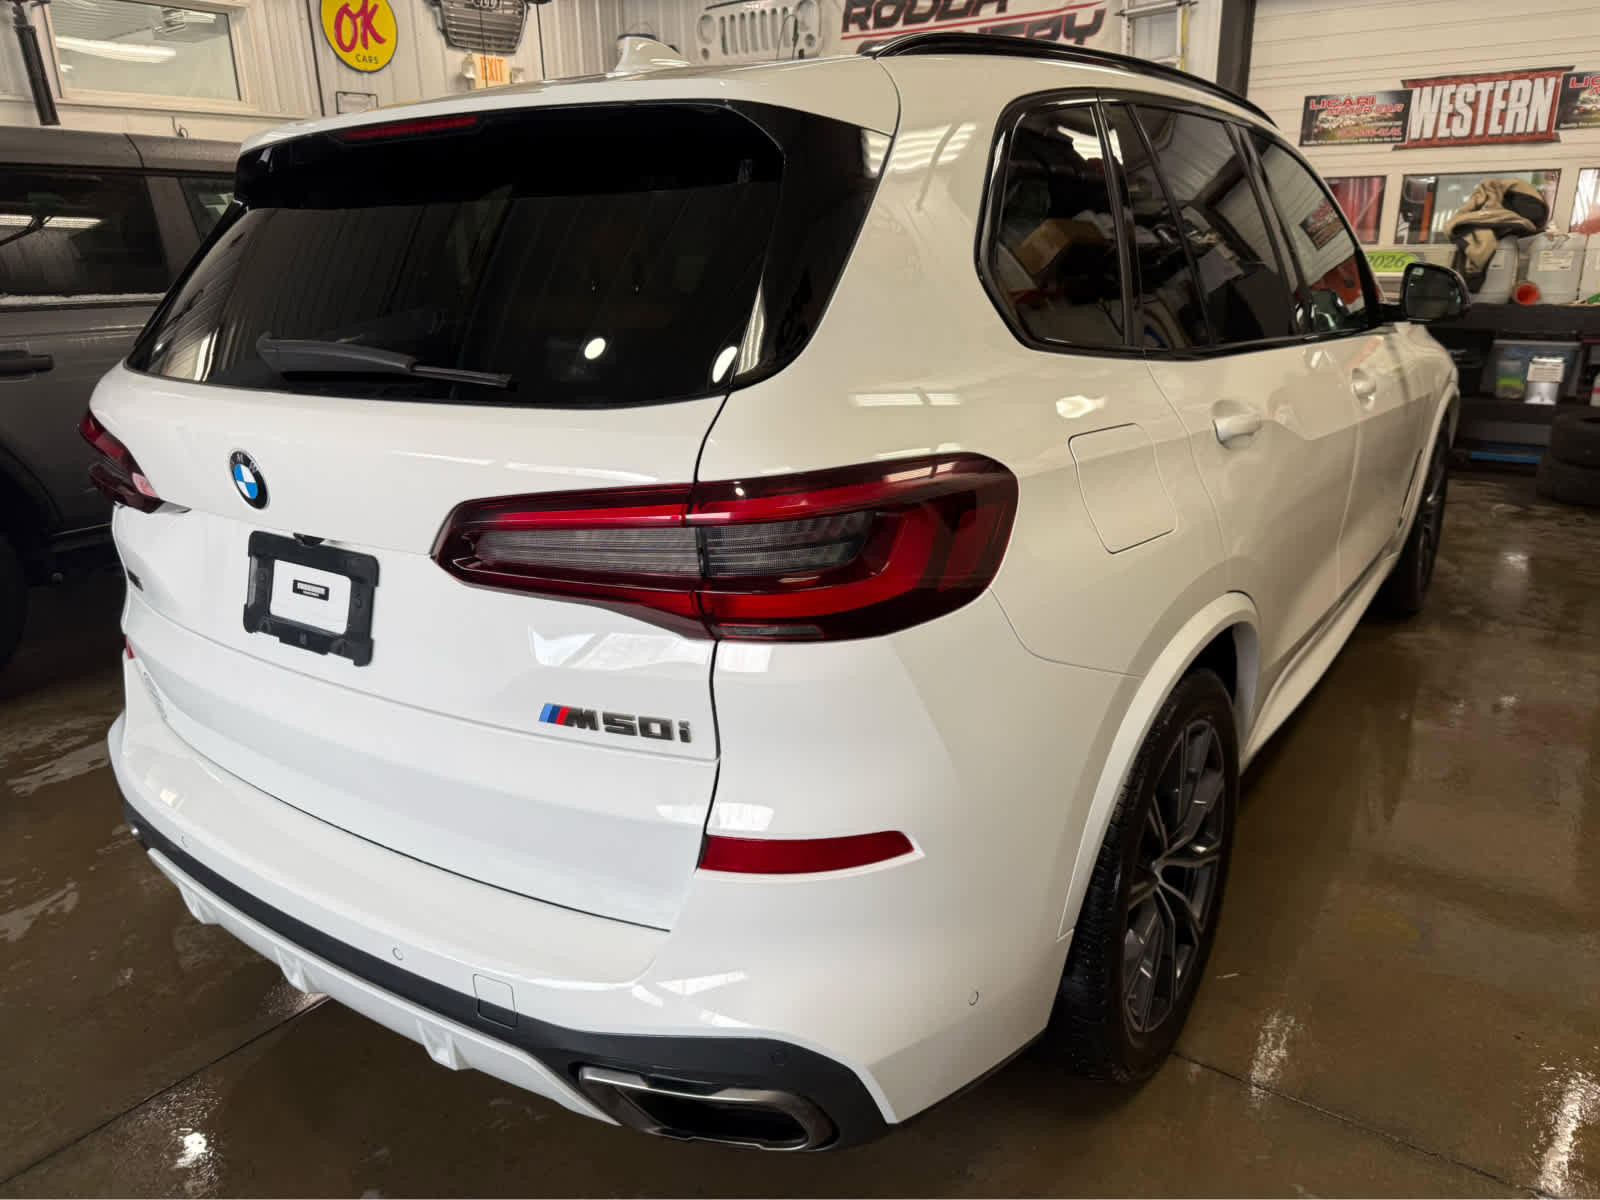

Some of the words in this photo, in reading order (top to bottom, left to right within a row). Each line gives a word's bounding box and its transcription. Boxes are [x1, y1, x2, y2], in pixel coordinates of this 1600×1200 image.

[334, 0, 387, 53] OK
[355, 54, 380, 65] CARS
[480, 57, 504, 82] EXIT
[1310, 96, 1377, 110] LICARI
[1410, 77, 1556, 140] WESTERN
[564, 704, 692, 744] M50i
